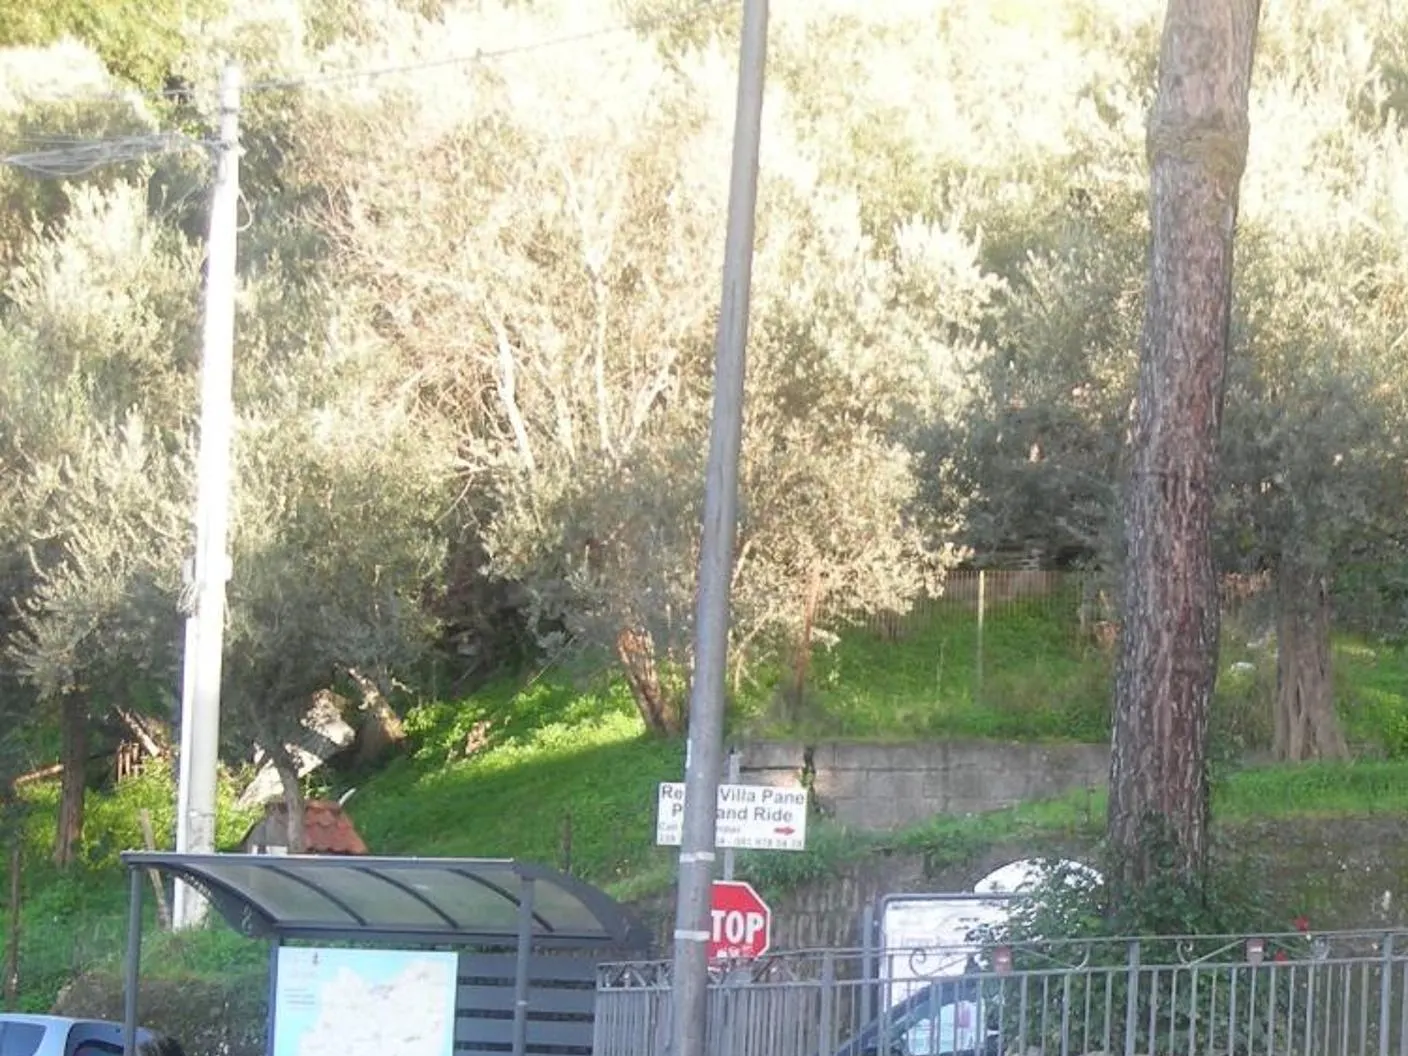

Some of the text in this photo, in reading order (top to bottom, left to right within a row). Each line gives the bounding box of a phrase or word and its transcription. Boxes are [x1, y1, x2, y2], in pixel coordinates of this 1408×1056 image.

[720, 787, 756, 802] Villa
[754, 806, 793, 823] Ride
[711, 909, 764, 944] TOP
